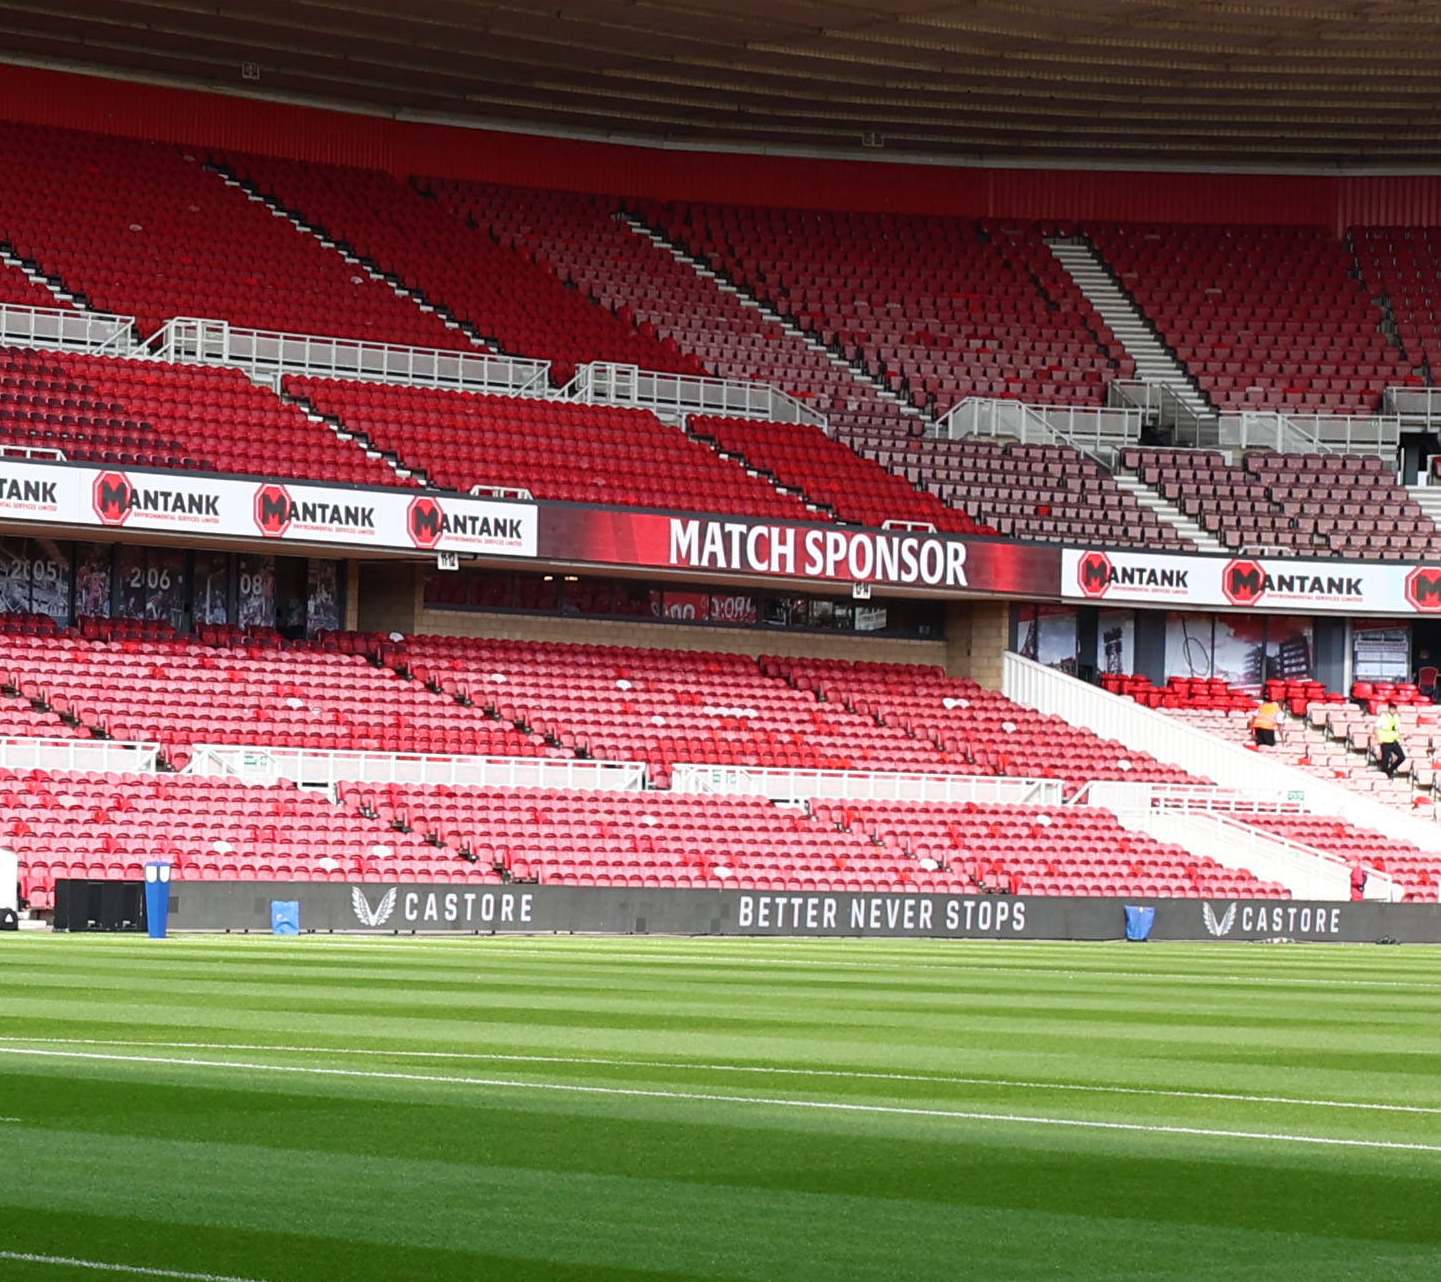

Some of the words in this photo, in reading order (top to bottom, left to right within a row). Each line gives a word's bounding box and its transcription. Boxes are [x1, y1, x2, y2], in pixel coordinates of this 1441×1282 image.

[101, 480, 220, 516] MANTANK
[263, 494, 375, 528] MANTANK
[416, 507, 522, 539] MANTANK
[669, 518, 796, 575] MATCH
[805, 529, 967, 588] SPONSOR
[1086, 559, 1189, 589] MANTANK
[1232, 568, 1363, 596] MANTANK
[404, 892, 533, 923] CASTORE
[739, 896, 837, 928] BETTER
[850, 898, 933, 930] NEVER
[945, 900, 1026, 931] STOPS
[1243, 907, 1341, 933] CASTORE
